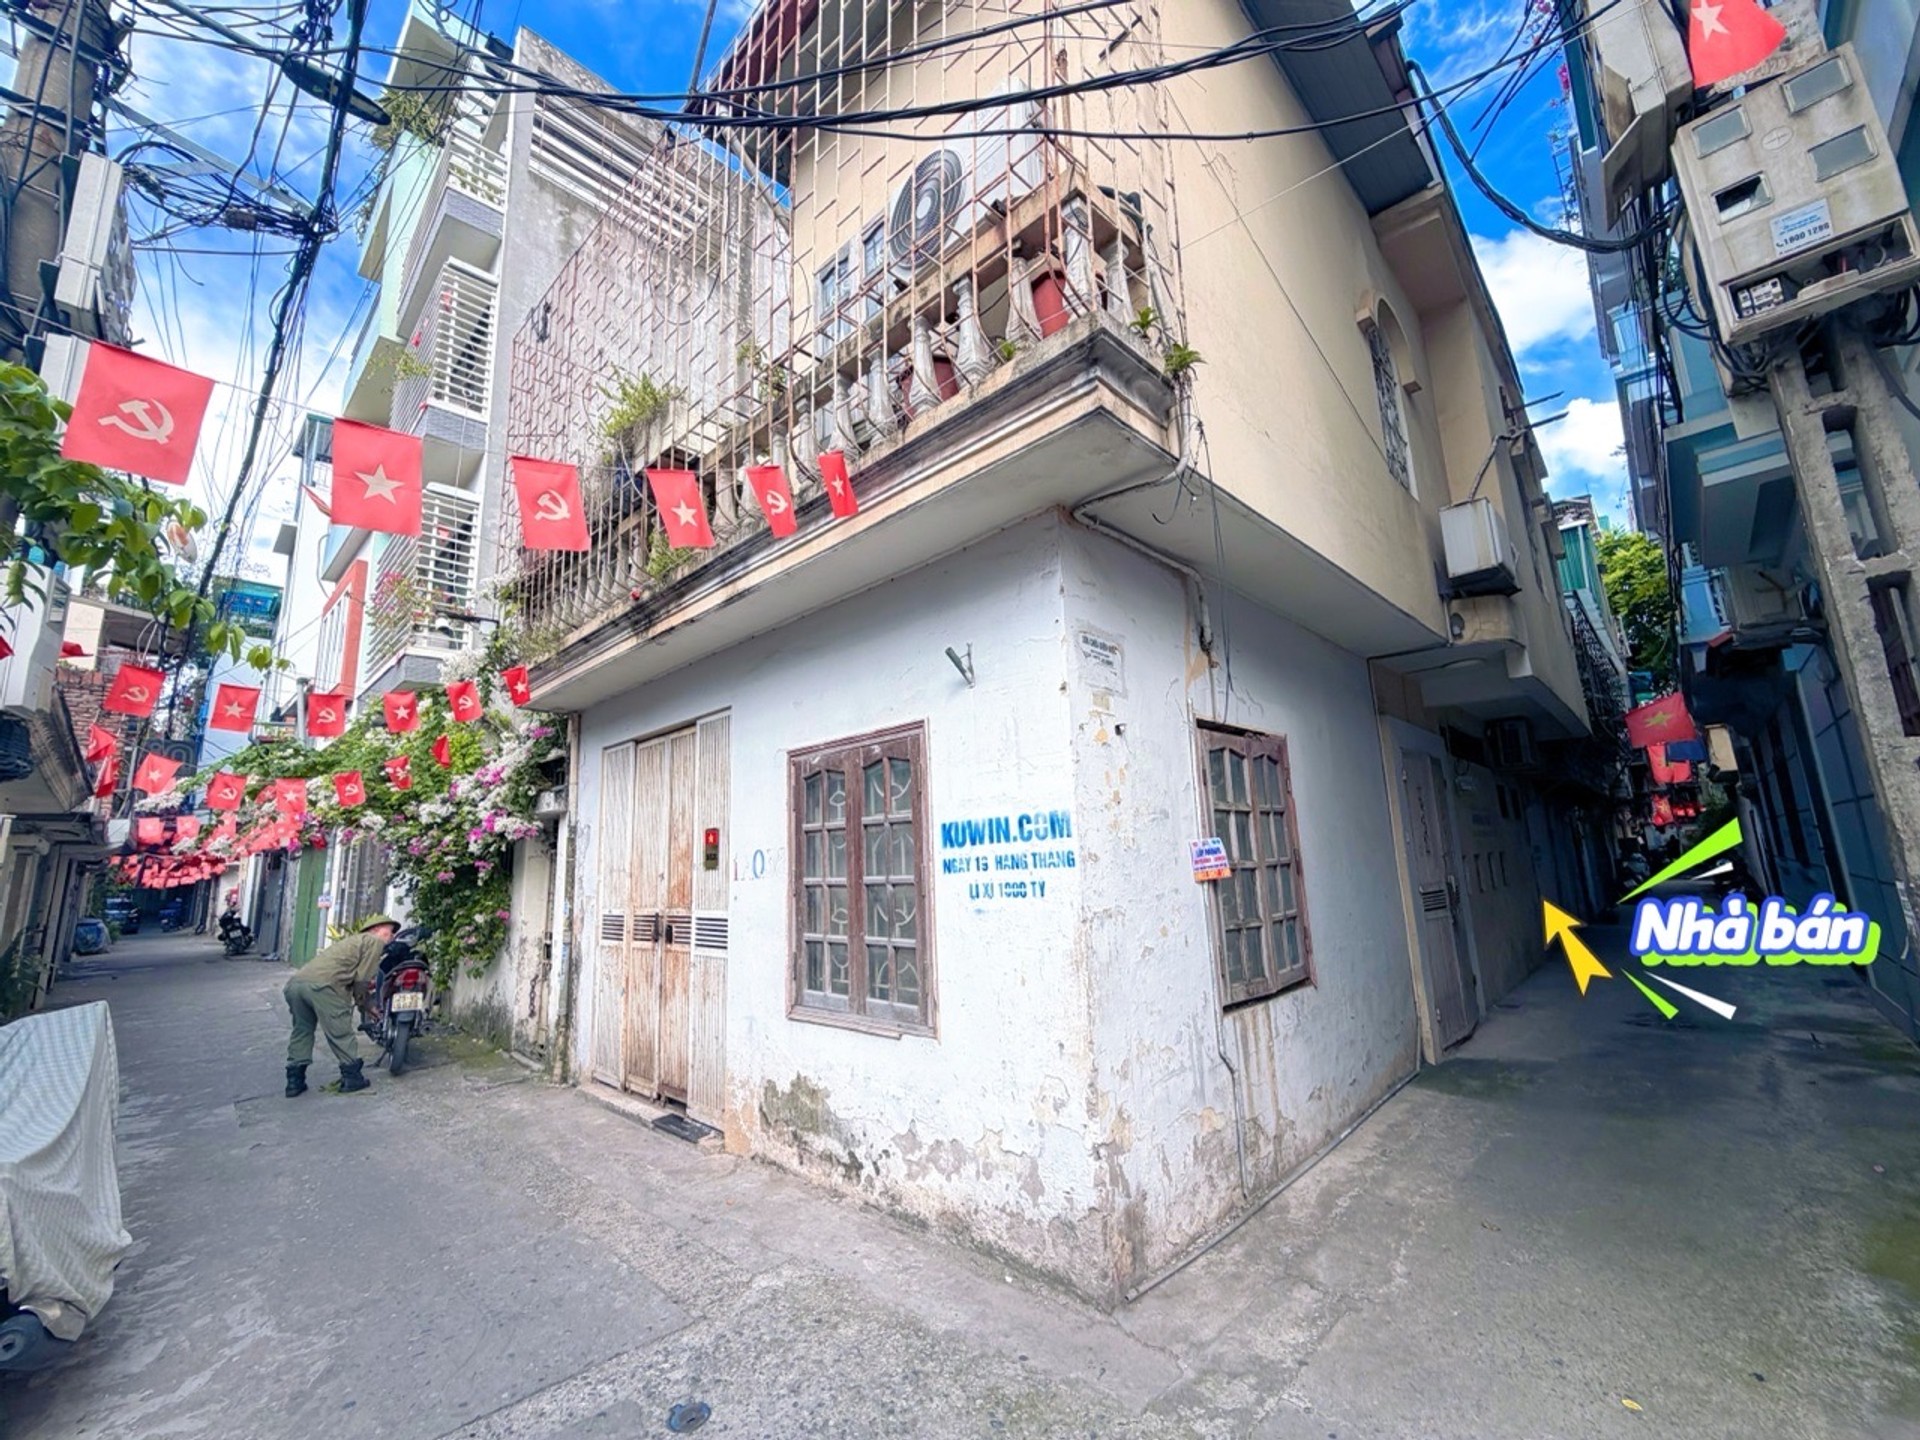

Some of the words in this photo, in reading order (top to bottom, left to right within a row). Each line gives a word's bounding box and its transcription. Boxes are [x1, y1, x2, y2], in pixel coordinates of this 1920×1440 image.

[941, 810, 1073, 849] KUWIN.COM
[943, 857, 972, 874] NGAY
[995, 853, 1029, 870] HANG
[1031, 850, 1076, 869] THANG
